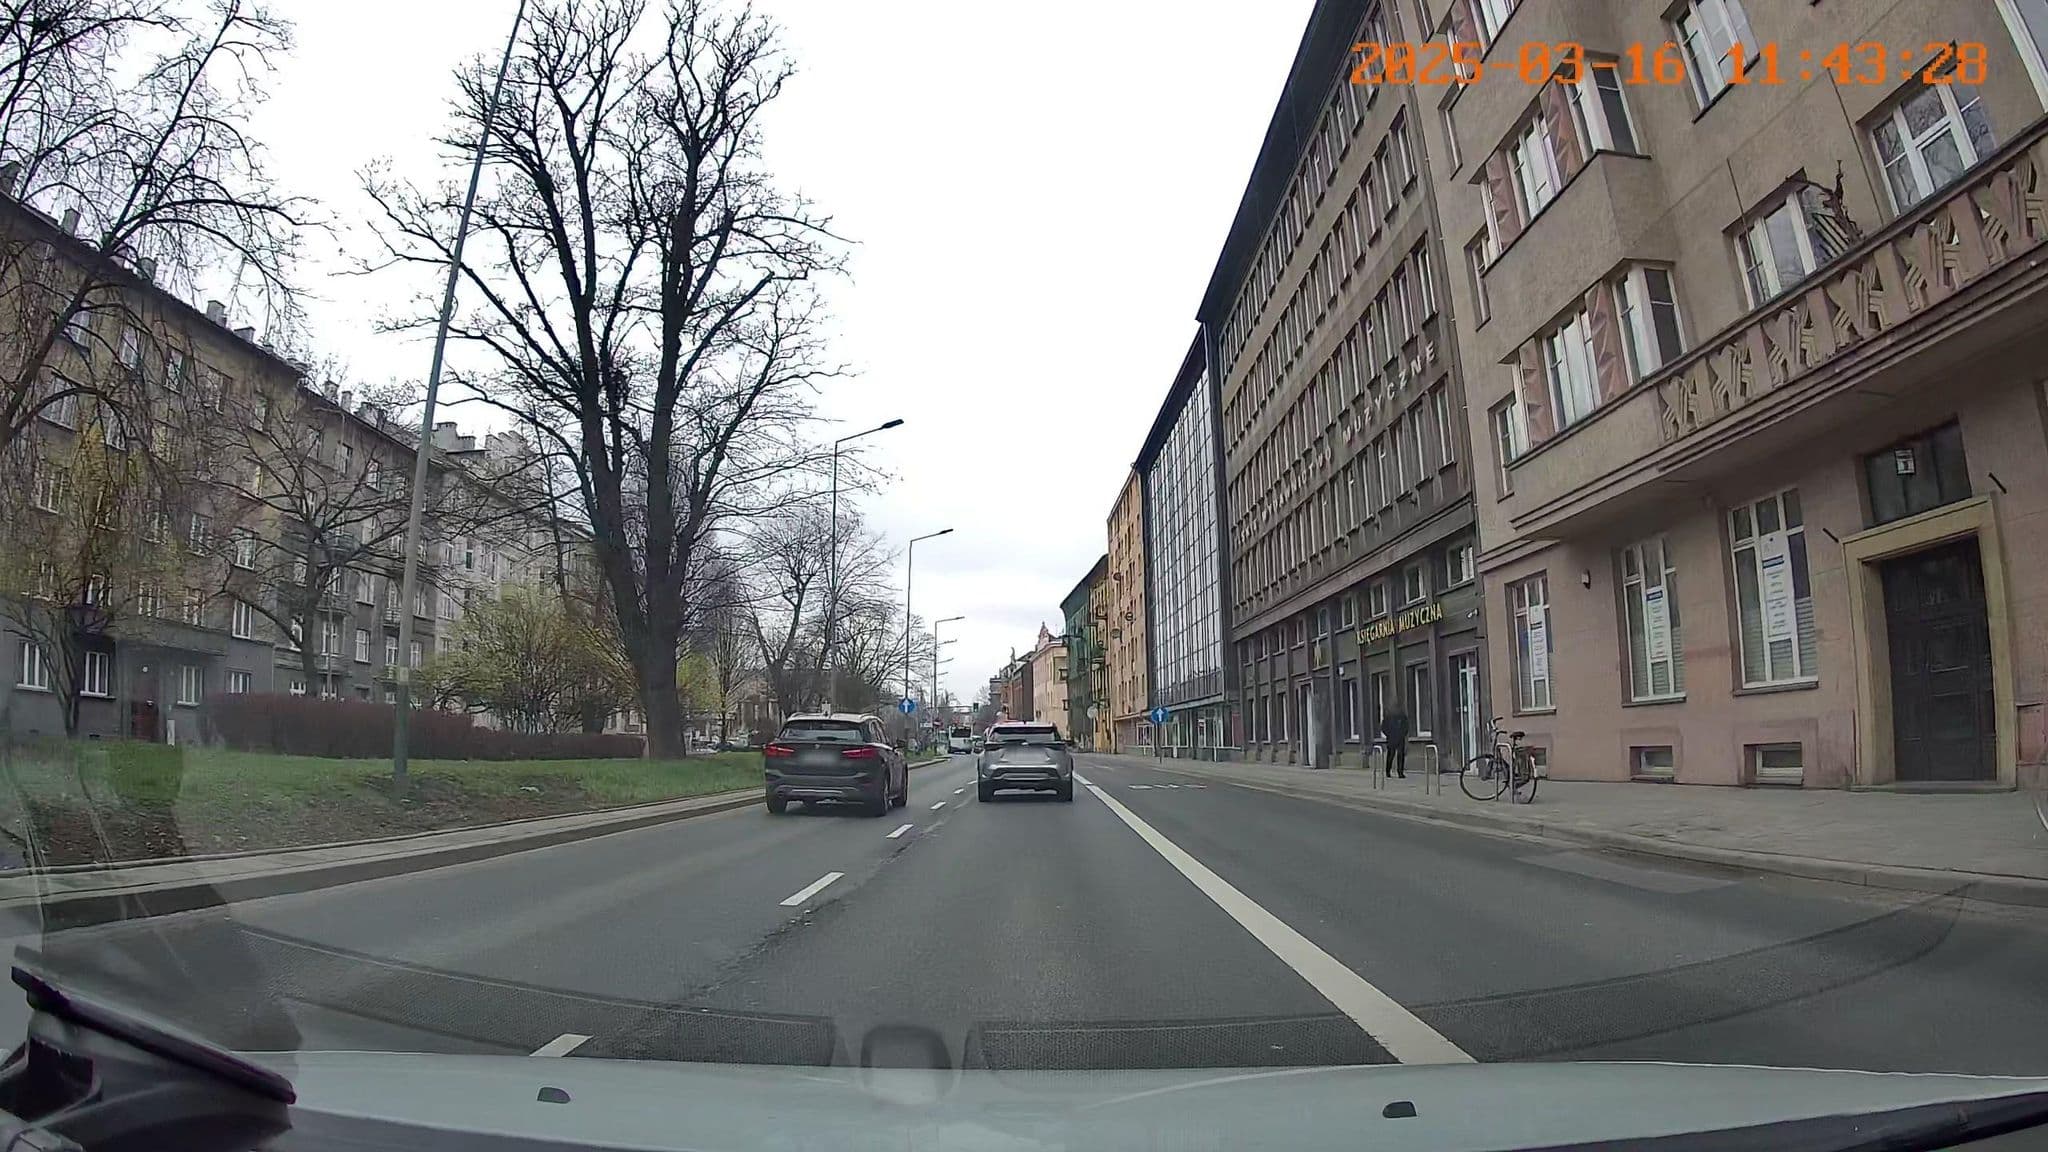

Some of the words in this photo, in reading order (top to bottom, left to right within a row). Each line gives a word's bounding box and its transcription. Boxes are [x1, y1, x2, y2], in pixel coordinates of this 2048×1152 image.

[1342, 340, 1436, 443] MUZYCZNE
[1356, 618, 1396, 645] KSIĘGARNIA
[1398, 602, 1443, 633] MUZYCZNA
